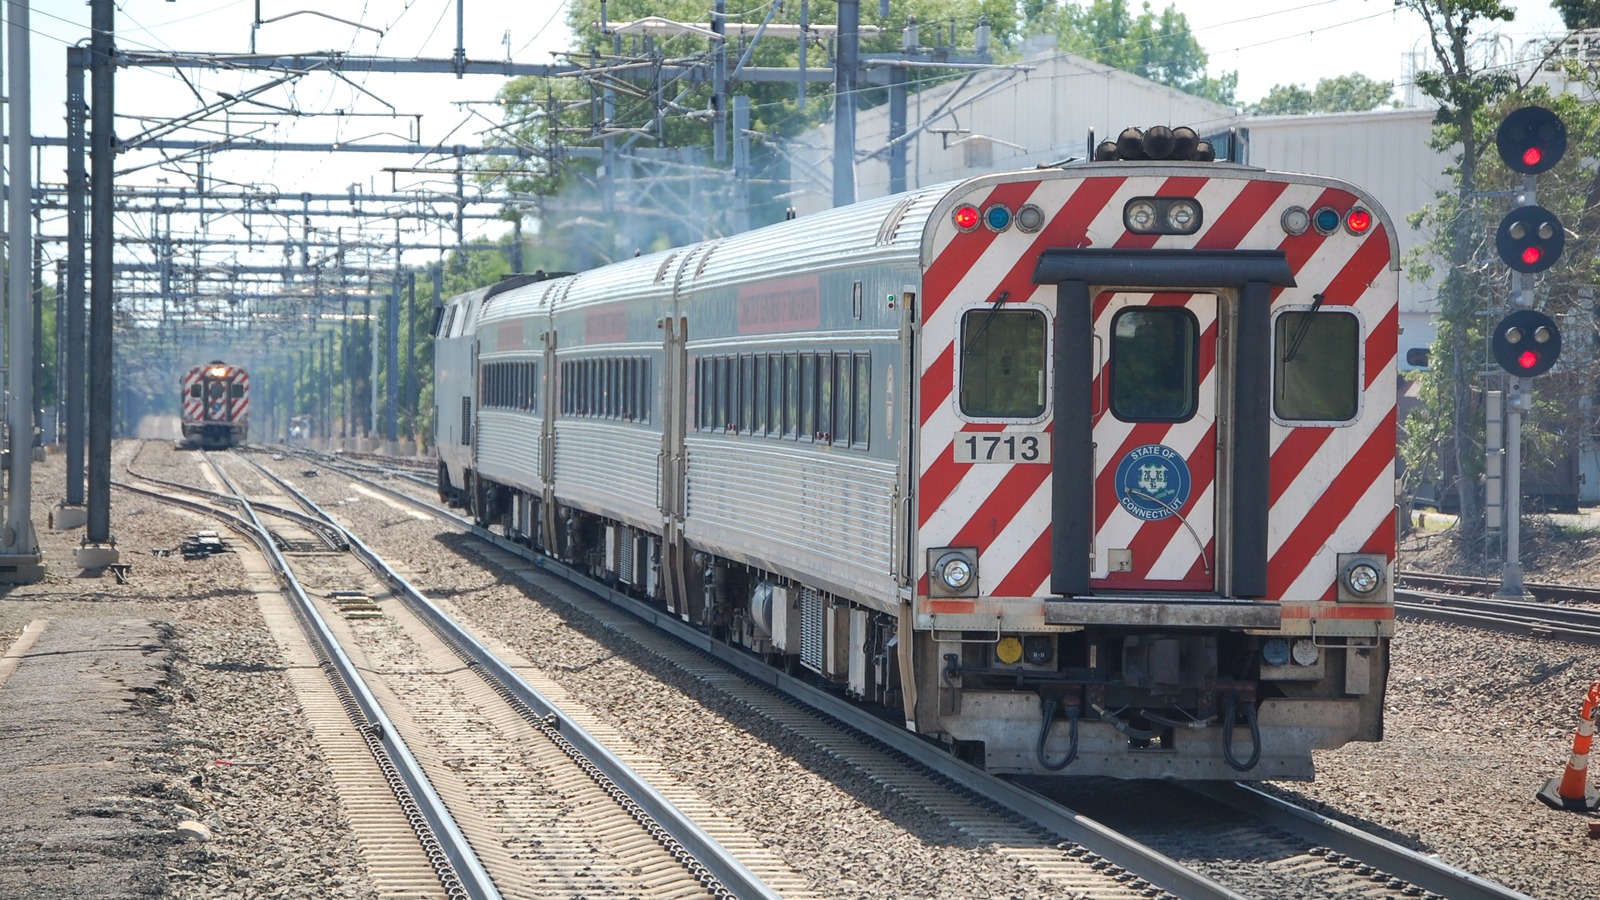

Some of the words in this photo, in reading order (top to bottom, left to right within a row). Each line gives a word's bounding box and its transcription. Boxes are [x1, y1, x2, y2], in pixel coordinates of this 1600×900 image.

[965, 436, 1039, 461] 1713
[1131, 446, 1160, 460] STATE
[1162, 449, 1176, 459] OF
